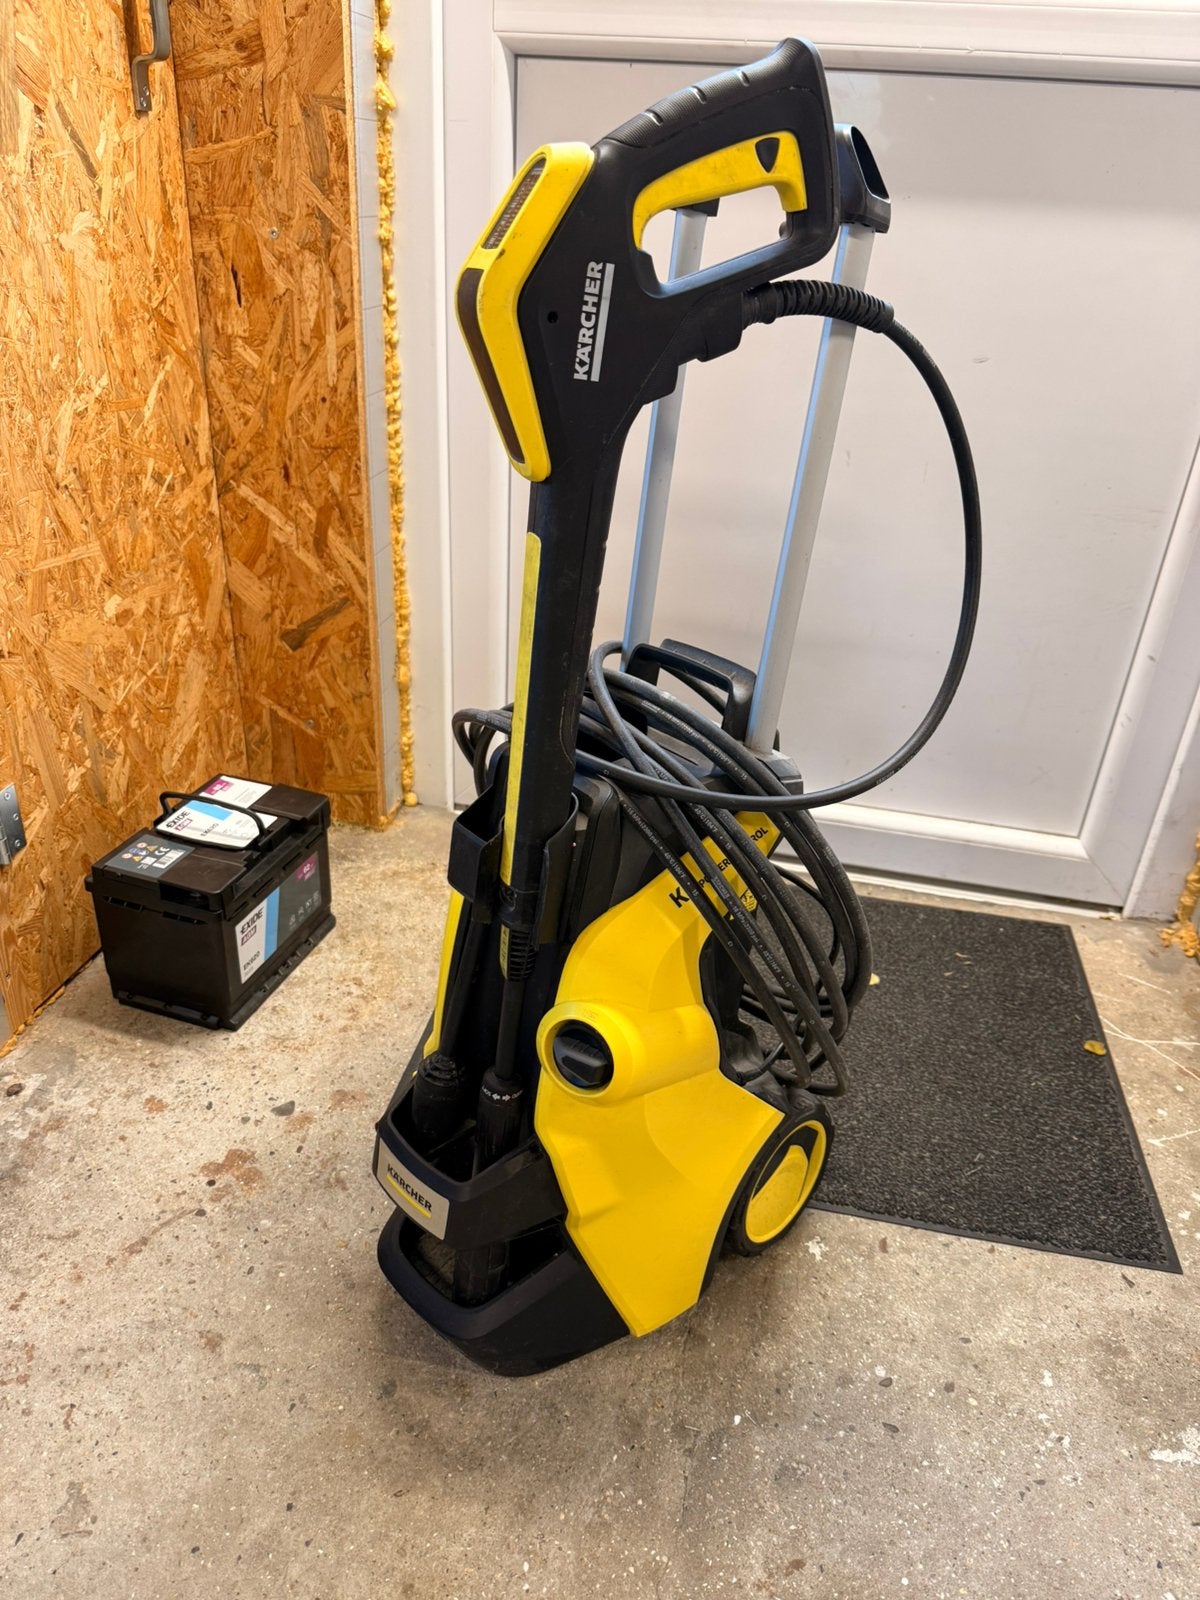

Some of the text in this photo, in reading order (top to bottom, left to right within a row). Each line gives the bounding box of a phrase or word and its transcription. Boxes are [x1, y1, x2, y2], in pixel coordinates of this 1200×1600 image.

[573, 261, 603, 380] KÄRCHER
[166, 811, 191, 828] EXIDE
[669, 887, 690, 908] K
[240, 906, 264, 935] EXIDE
